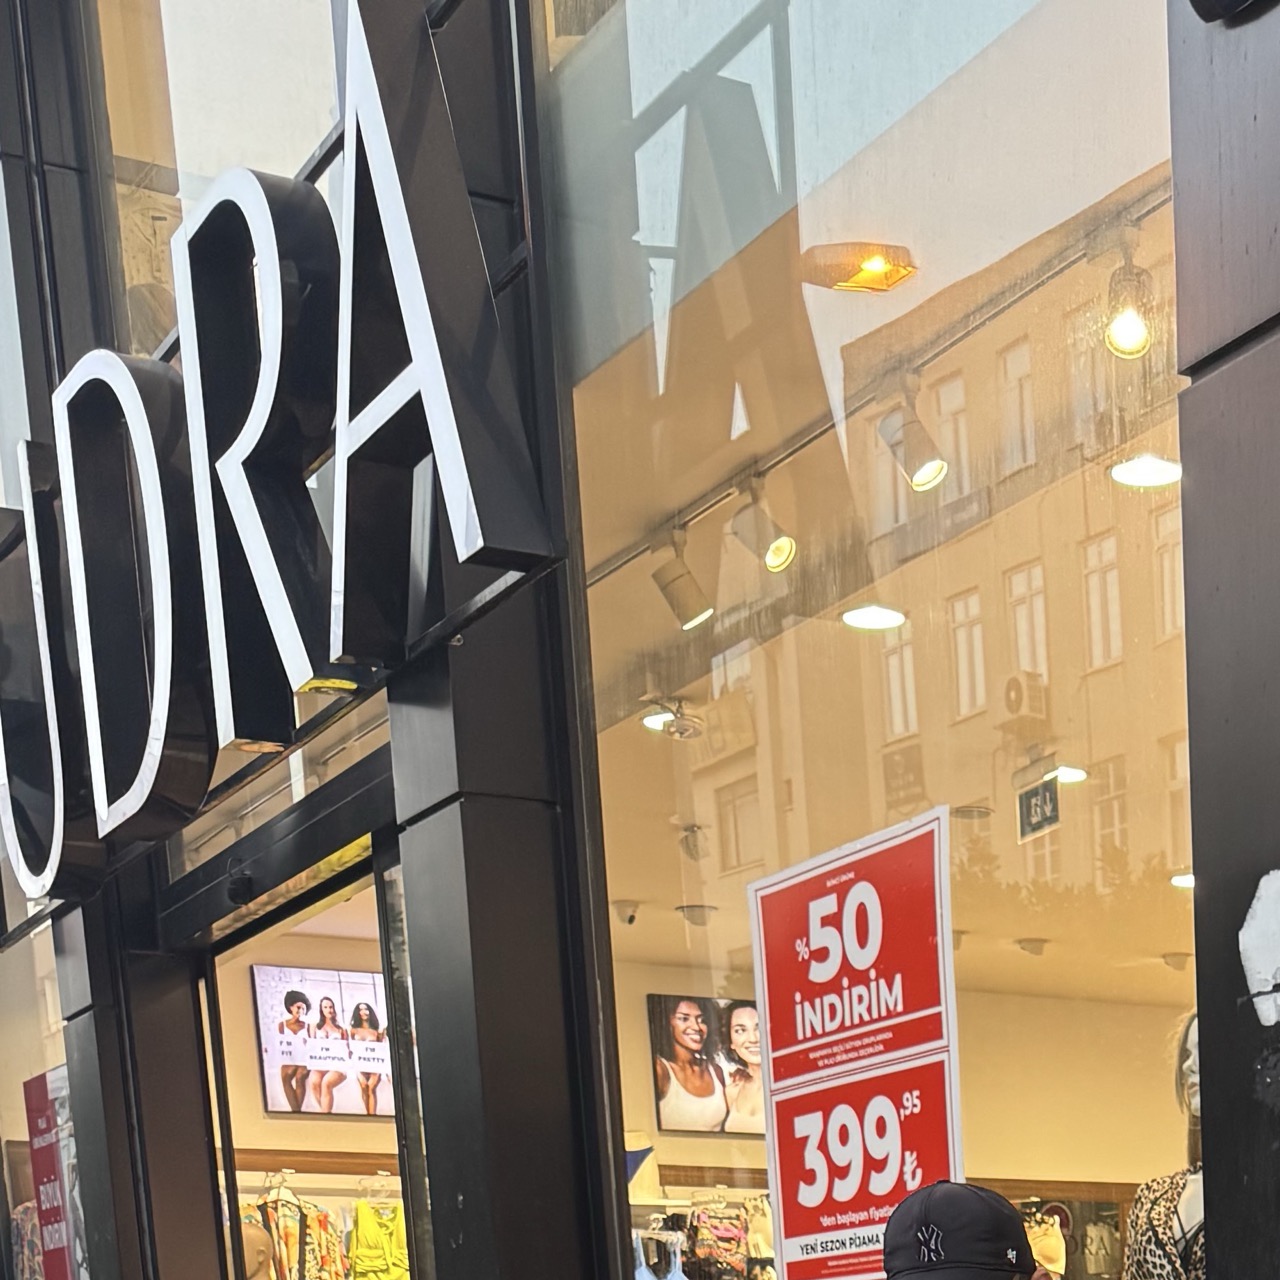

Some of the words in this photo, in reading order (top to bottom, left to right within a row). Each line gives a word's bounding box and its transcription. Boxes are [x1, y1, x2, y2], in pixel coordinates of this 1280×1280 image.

[795, 968, 904, 1040] İNDİRİM
[799, 1237, 819, 1256] YENİ
[819, 1236, 848, 1252] SEZON
[848, 1231, 881, 1250] PİJAMA
